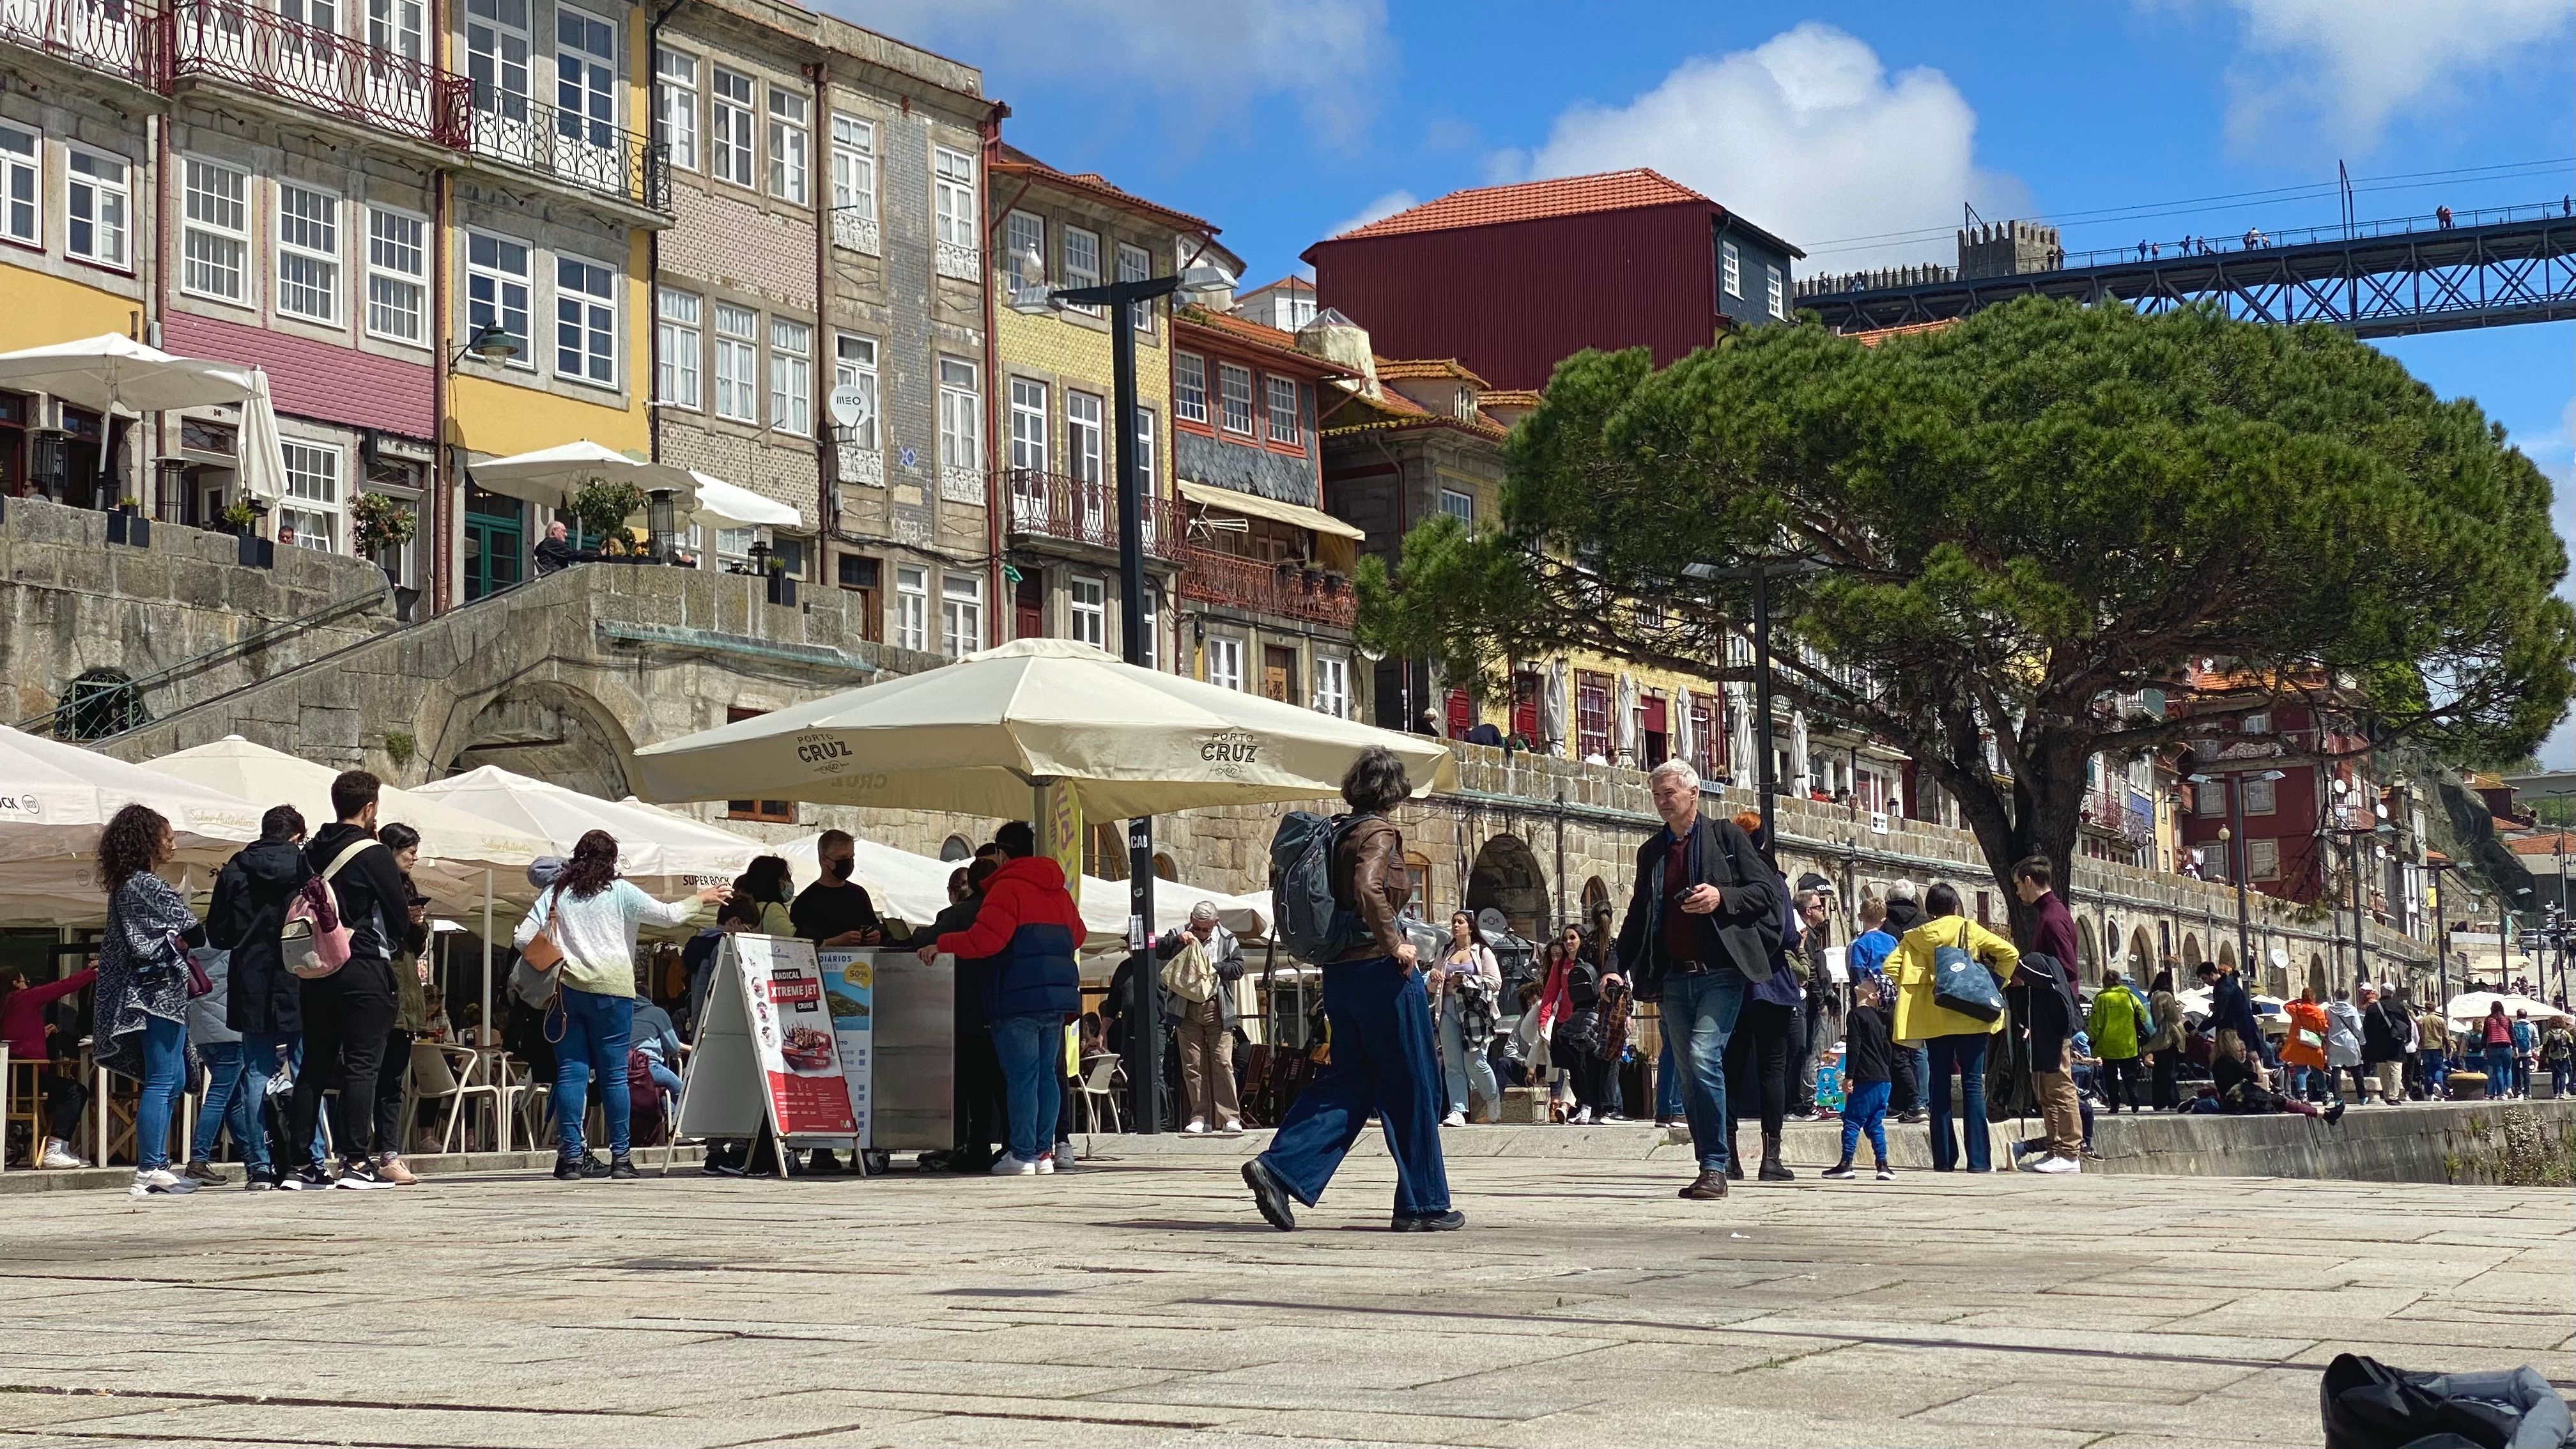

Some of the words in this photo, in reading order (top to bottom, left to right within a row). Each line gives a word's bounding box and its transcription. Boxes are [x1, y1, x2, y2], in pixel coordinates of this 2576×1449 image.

[837, 396, 861, 405] MEO
[797, 734, 834, 745] PORTO
[1212, 733, 1253, 741] PORTO
[798, 741, 852, 763] CRUZ
[1201, 743, 1258, 763] CRUZ
[0, 797, 20, 809] CK
[683, 875, 709, 886] SUPER
[1483, 917, 1499, 926] NOS
[774, 971, 800, 980] RADICAL
[770, 985, 804, 998] XTREME
[805, 984, 817, 998] JET
